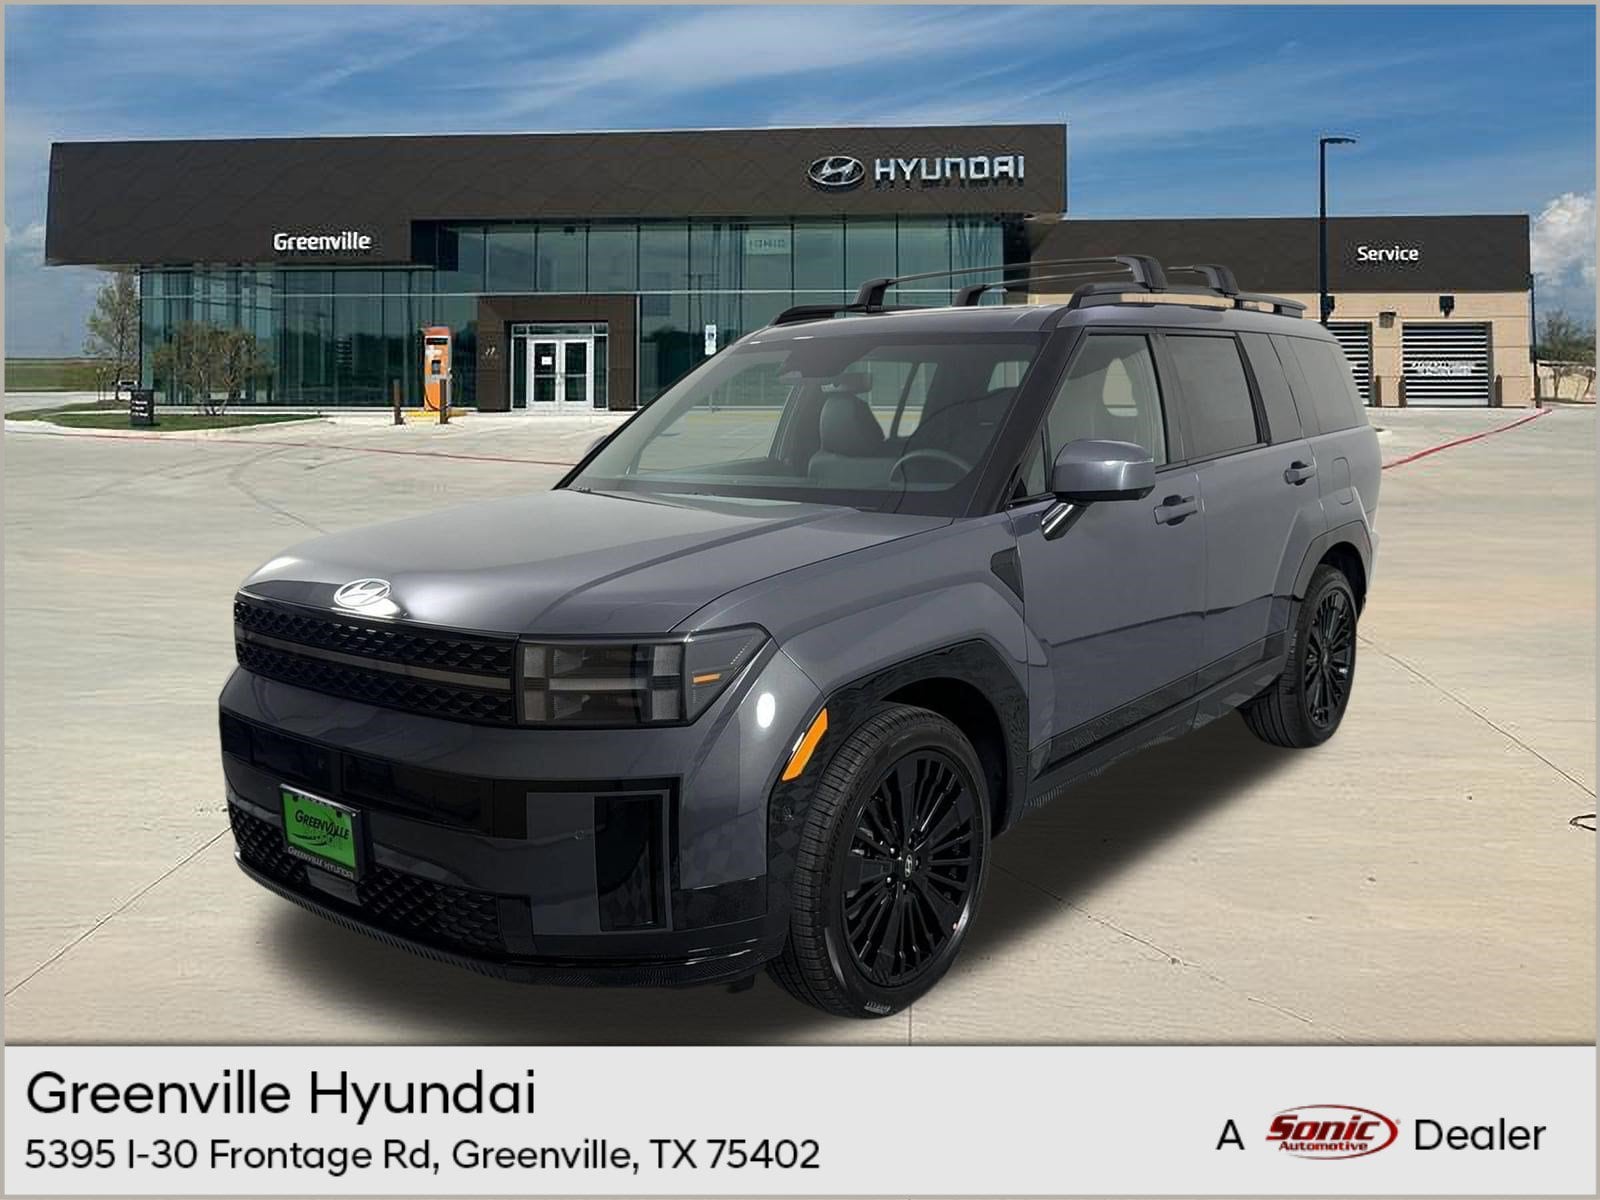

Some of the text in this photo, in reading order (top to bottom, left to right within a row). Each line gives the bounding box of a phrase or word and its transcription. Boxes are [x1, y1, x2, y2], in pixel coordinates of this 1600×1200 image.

[874, 155, 1025, 181] HYUNDAI
[273, 231, 371, 251] Greenville
[1357, 245, 1419, 262] Service
[295, 809, 350, 840] GREENVILLE
